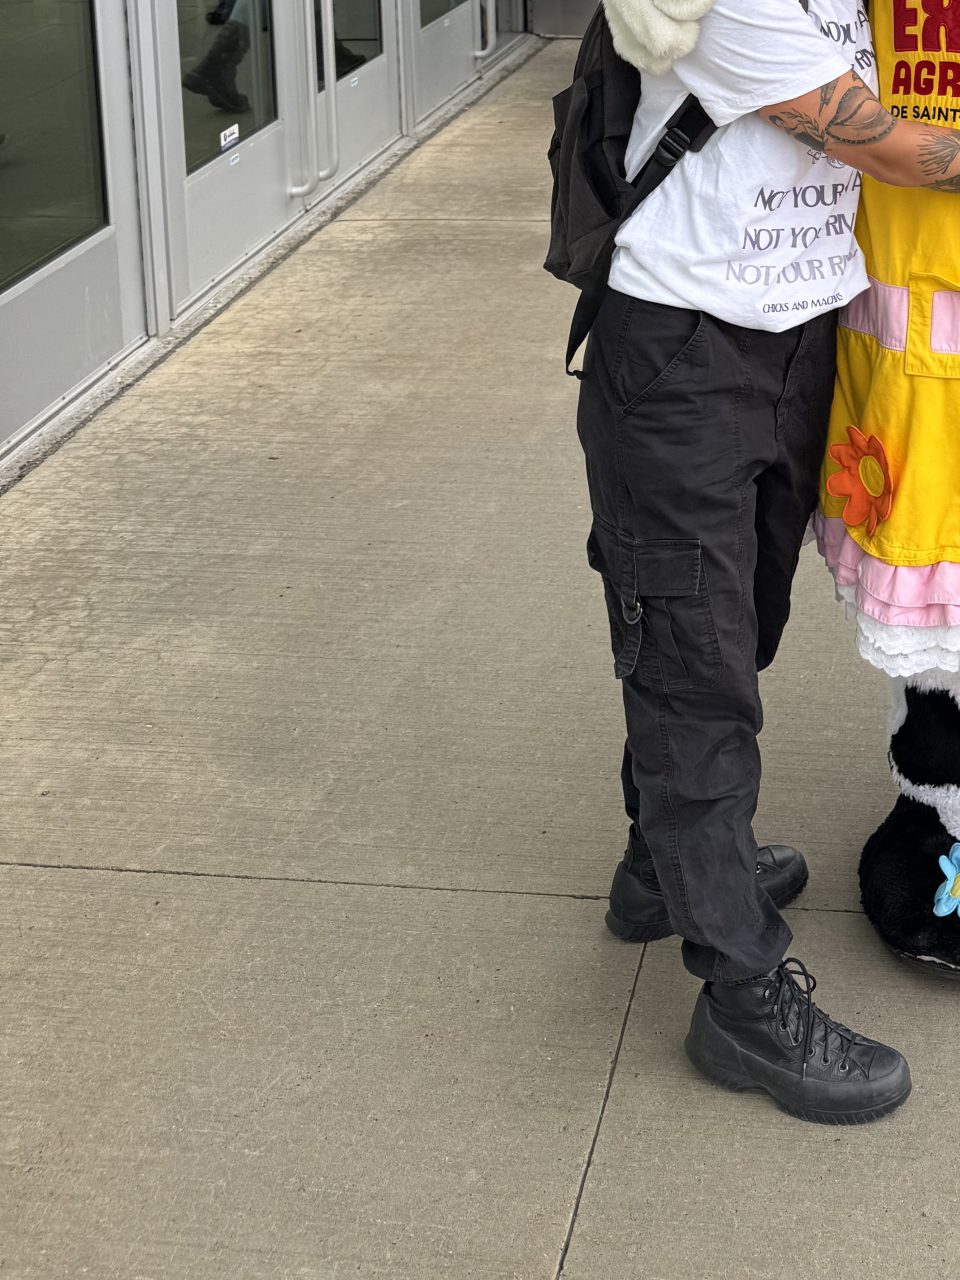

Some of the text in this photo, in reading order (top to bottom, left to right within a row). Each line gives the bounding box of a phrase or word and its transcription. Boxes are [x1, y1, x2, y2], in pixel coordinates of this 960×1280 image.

[890, 105, 908, 119] DE
[792, 183, 845, 208] YOUR
[742, 227, 785, 251] NOT
[725, 260, 776, 286] NOT
[792, 300, 808, 311] AND
